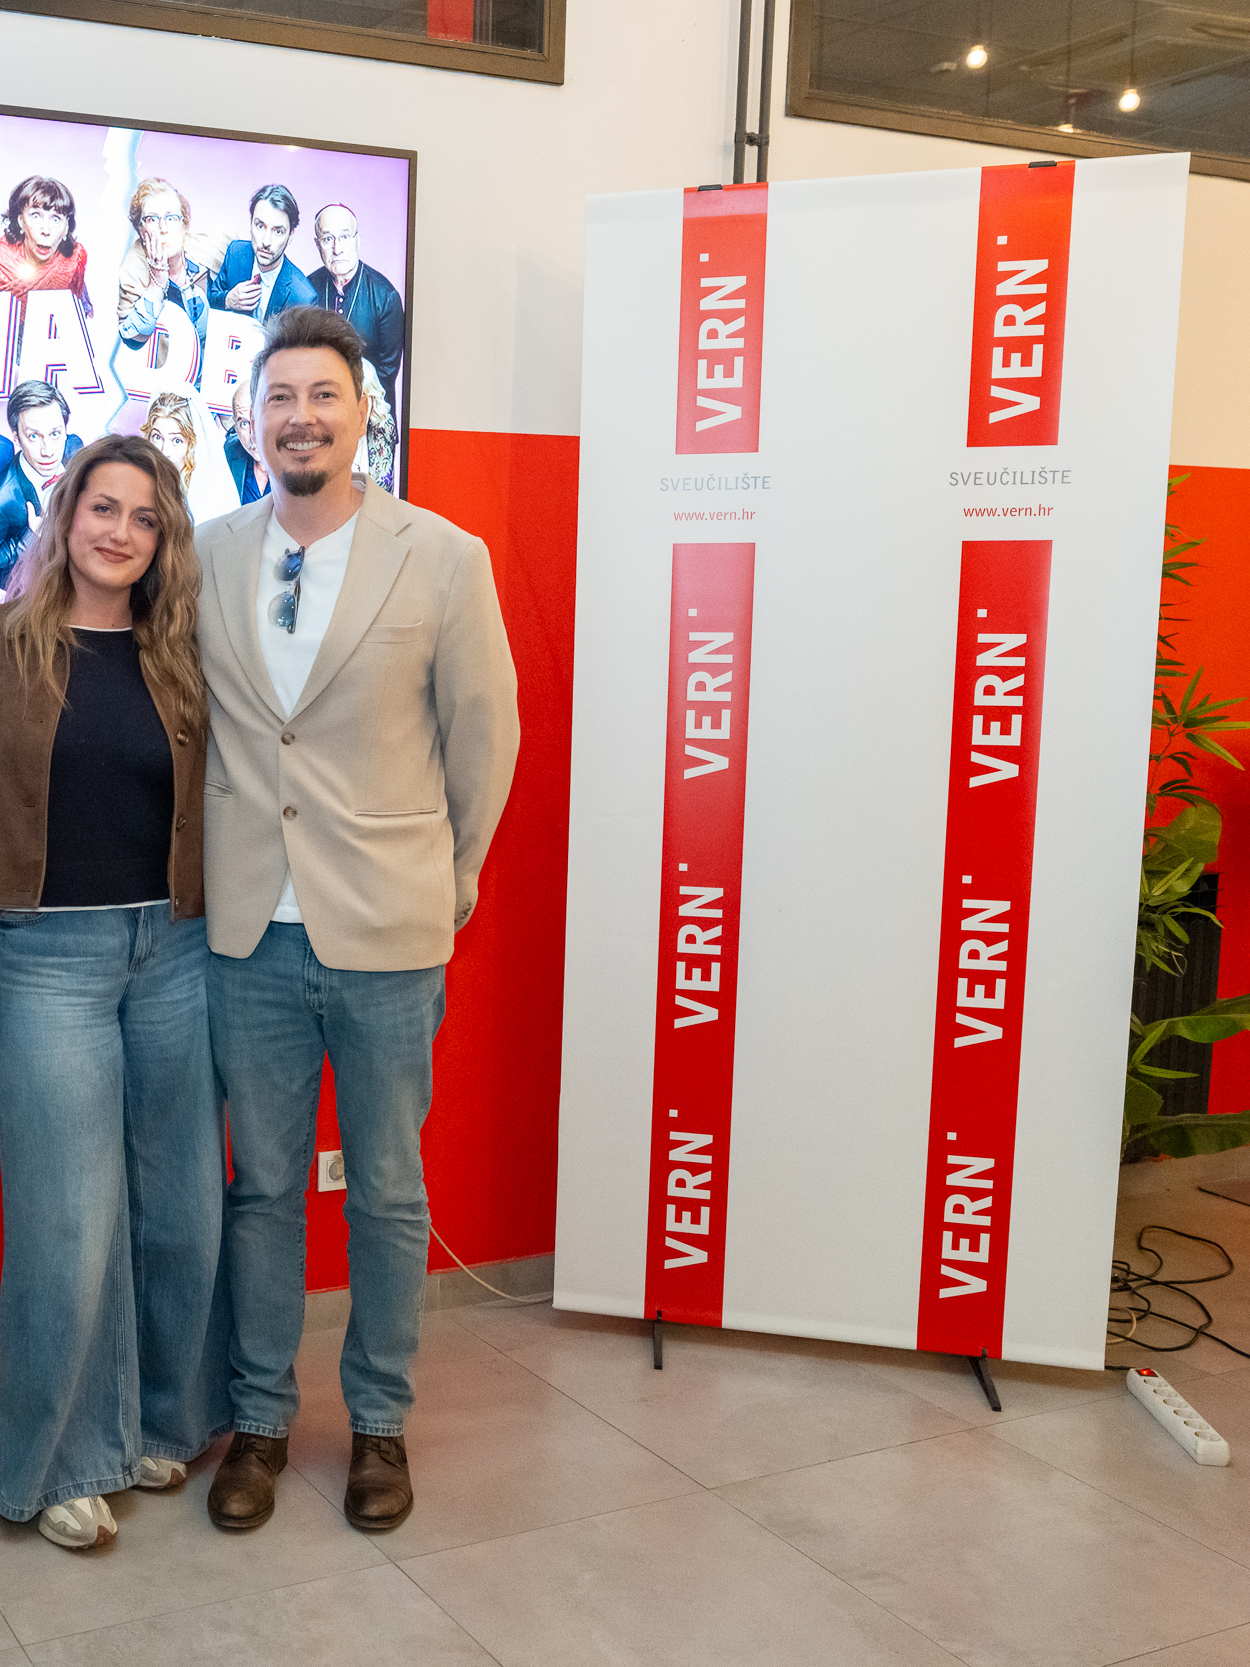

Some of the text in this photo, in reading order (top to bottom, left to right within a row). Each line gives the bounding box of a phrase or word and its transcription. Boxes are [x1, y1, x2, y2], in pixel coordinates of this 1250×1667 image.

[696, 276, 747, 432] VERN
[989, 259, 1049, 424] VERN
[659, 472, 772, 492] SVEUČILIŠTE
[673, 508, 756, 521] www.vern.hr
[949, 466, 1072, 486] SVEUČILIŠTE
[963, 503, 1053, 517] www.vern.hr
[684, 632, 734, 780] VERN
[969, 633, 1028, 788] VERN
[674, 886, 724, 1029] VERN
[954, 899, 1011, 1048] VERN
[664, 1131, 714, 1270] VERN
[939, 1155, 995, 1298] VERN
